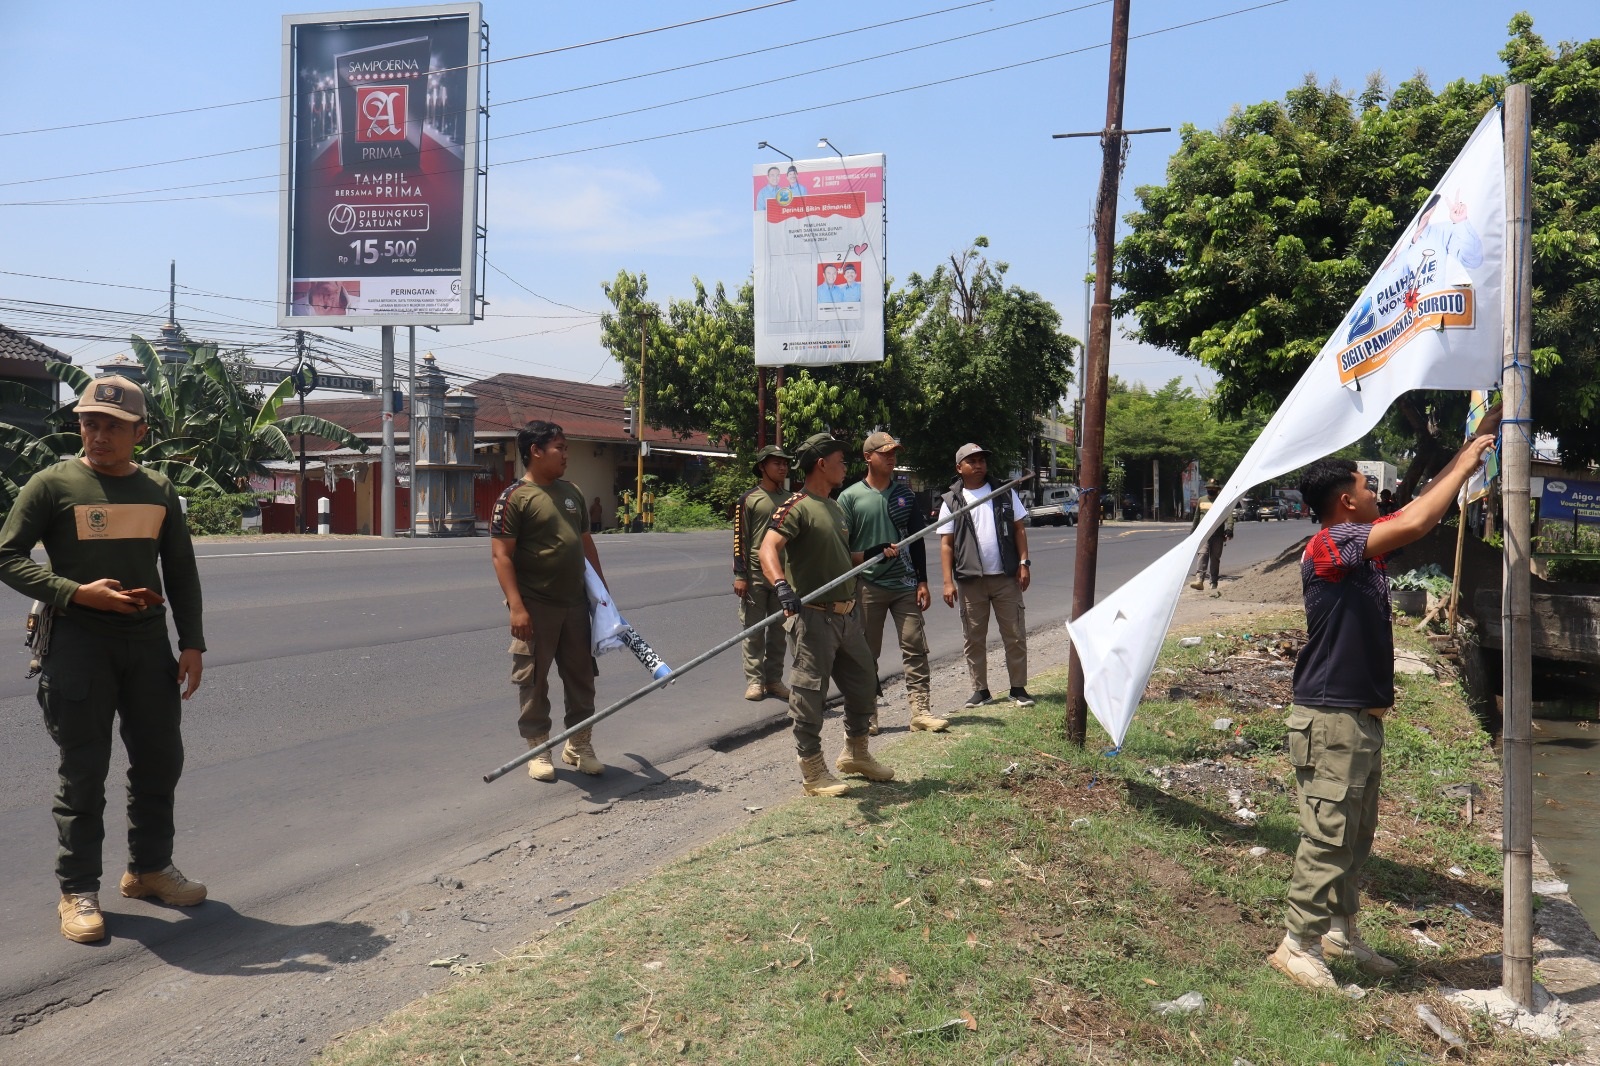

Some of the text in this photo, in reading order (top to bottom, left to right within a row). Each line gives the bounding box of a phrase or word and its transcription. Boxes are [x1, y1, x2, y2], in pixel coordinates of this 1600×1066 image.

[348, 59, 419, 73] SAMPOERNA
[362, 146, 402, 160] PRIMA
[354, 172, 408, 186] TAMPIL
[812, 176, 820, 188] 2
[376, 186, 422, 198] PRIMA
[360, 210, 424, 218] DIBUNGKUS
[360, 219, 402, 228] SATUAN
[338, 256, 348, 264] Rp
[1342, 344, 1365, 371] SIGIT
[1364, 310, 1413, 356] PAMUNGKAS
[1418, 294, 1464, 316] SUROTO
[782, 342, 788, 350] 2
[1572, 492, 1594, 502] Aigo
